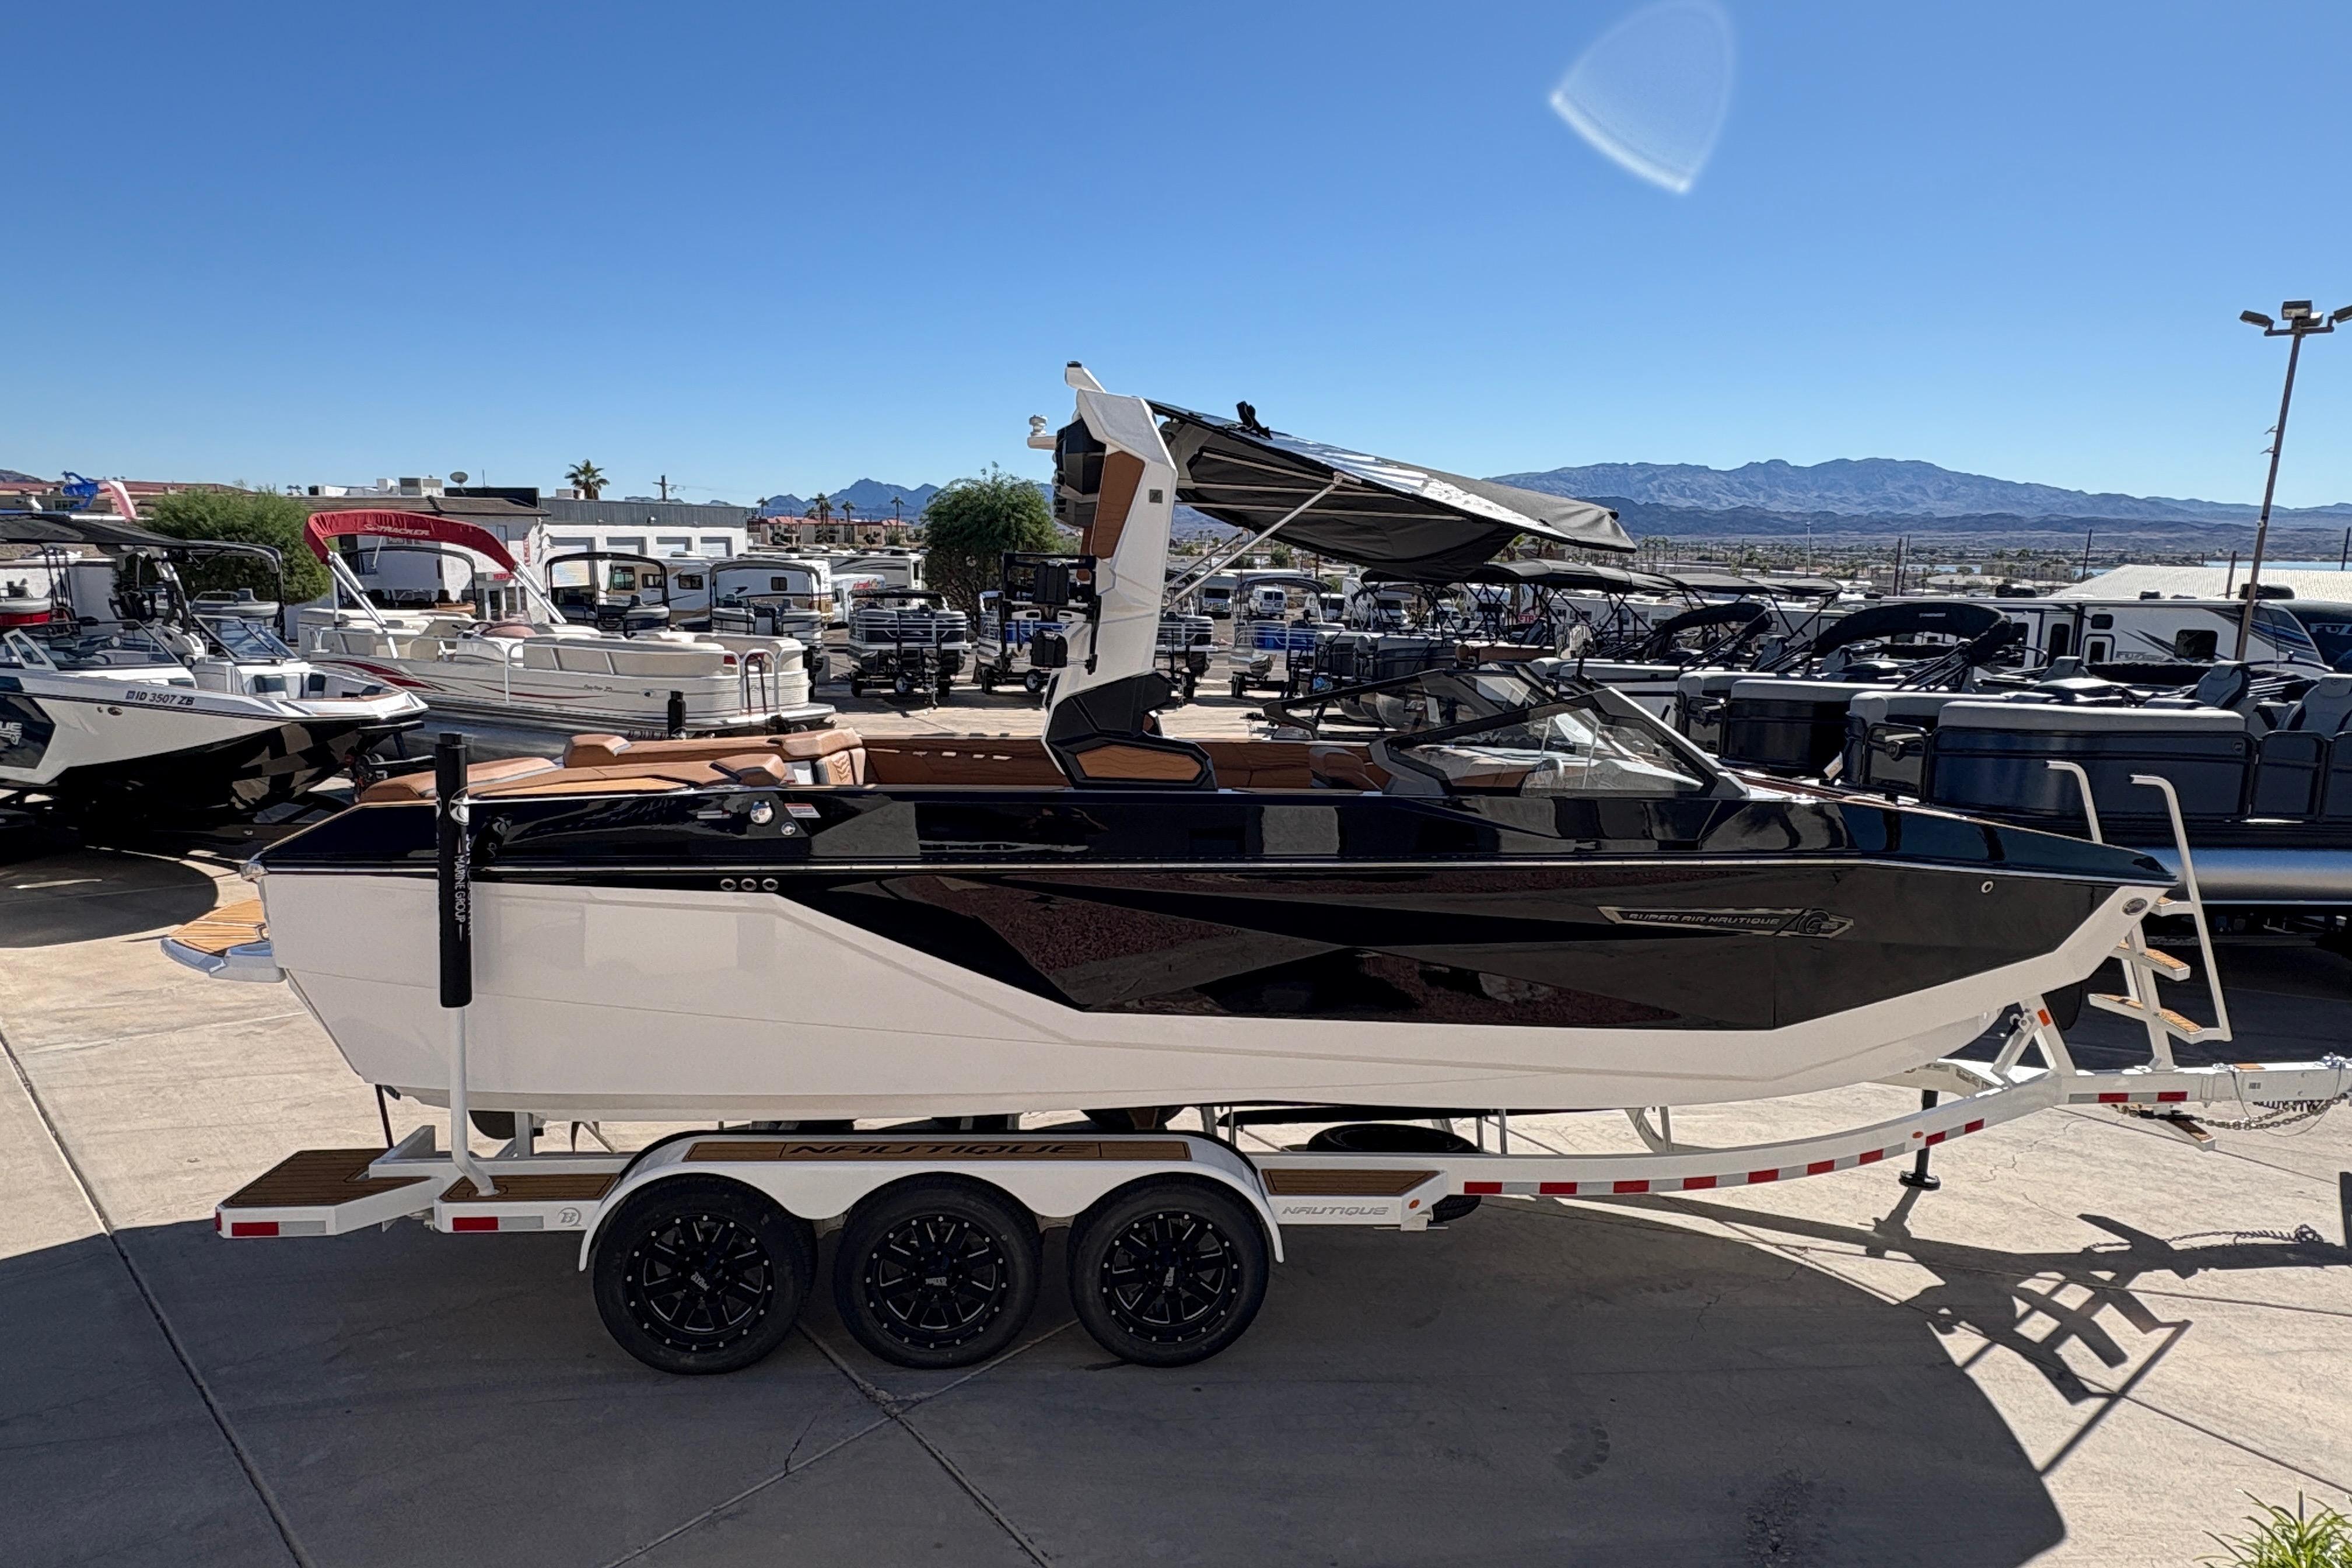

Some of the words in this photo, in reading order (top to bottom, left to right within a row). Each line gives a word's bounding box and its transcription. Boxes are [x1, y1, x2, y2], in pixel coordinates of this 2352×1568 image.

[135, 691, 147, 701] ID
[149, 692, 176, 704] 3507
[177, 695, 195, 705] ZB
[454, 855, 466, 890] MARINE
[455, 891, 466, 923] GROUP
[1629, 913, 1679, 922] SUPER
[1708, 916, 1780, 925] NAUTIQUE
[789, 1144, 1093, 1154] NAUTIQUE
[1282, 1206, 1390, 1216] NAUTIQUE
